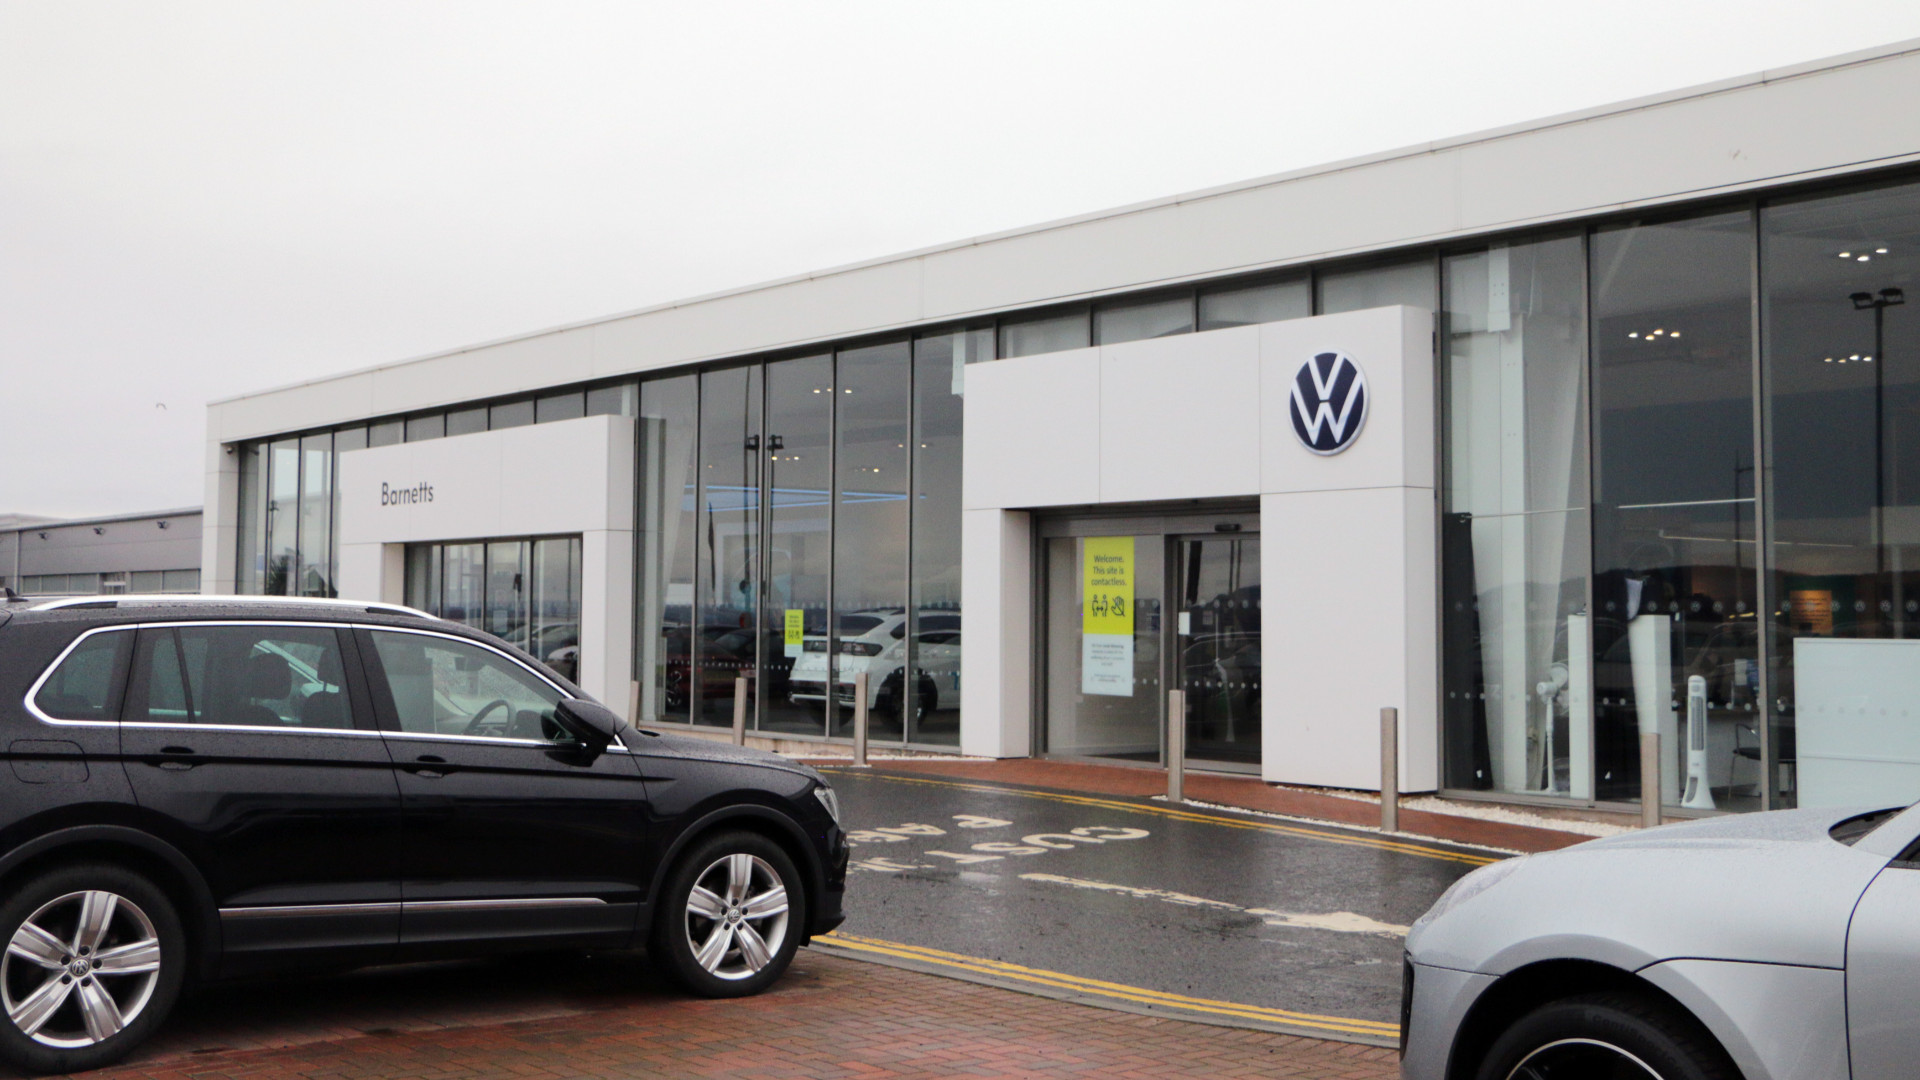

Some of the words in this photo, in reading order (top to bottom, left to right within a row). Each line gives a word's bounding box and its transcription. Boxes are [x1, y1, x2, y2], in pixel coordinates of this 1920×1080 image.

[1289, 350, 1368, 455] VW
[381, 481, 434, 506] Barnetts
[1093, 554, 1124, 563] Welcome.
[1093, 566, 1105, 575] This
[1106, 566, 1118, 575] site
[1118, 566, 1124, 575] is
[1091, 578, 1127, 587] contactless.
[846, 814, 1014, 848] PAR
